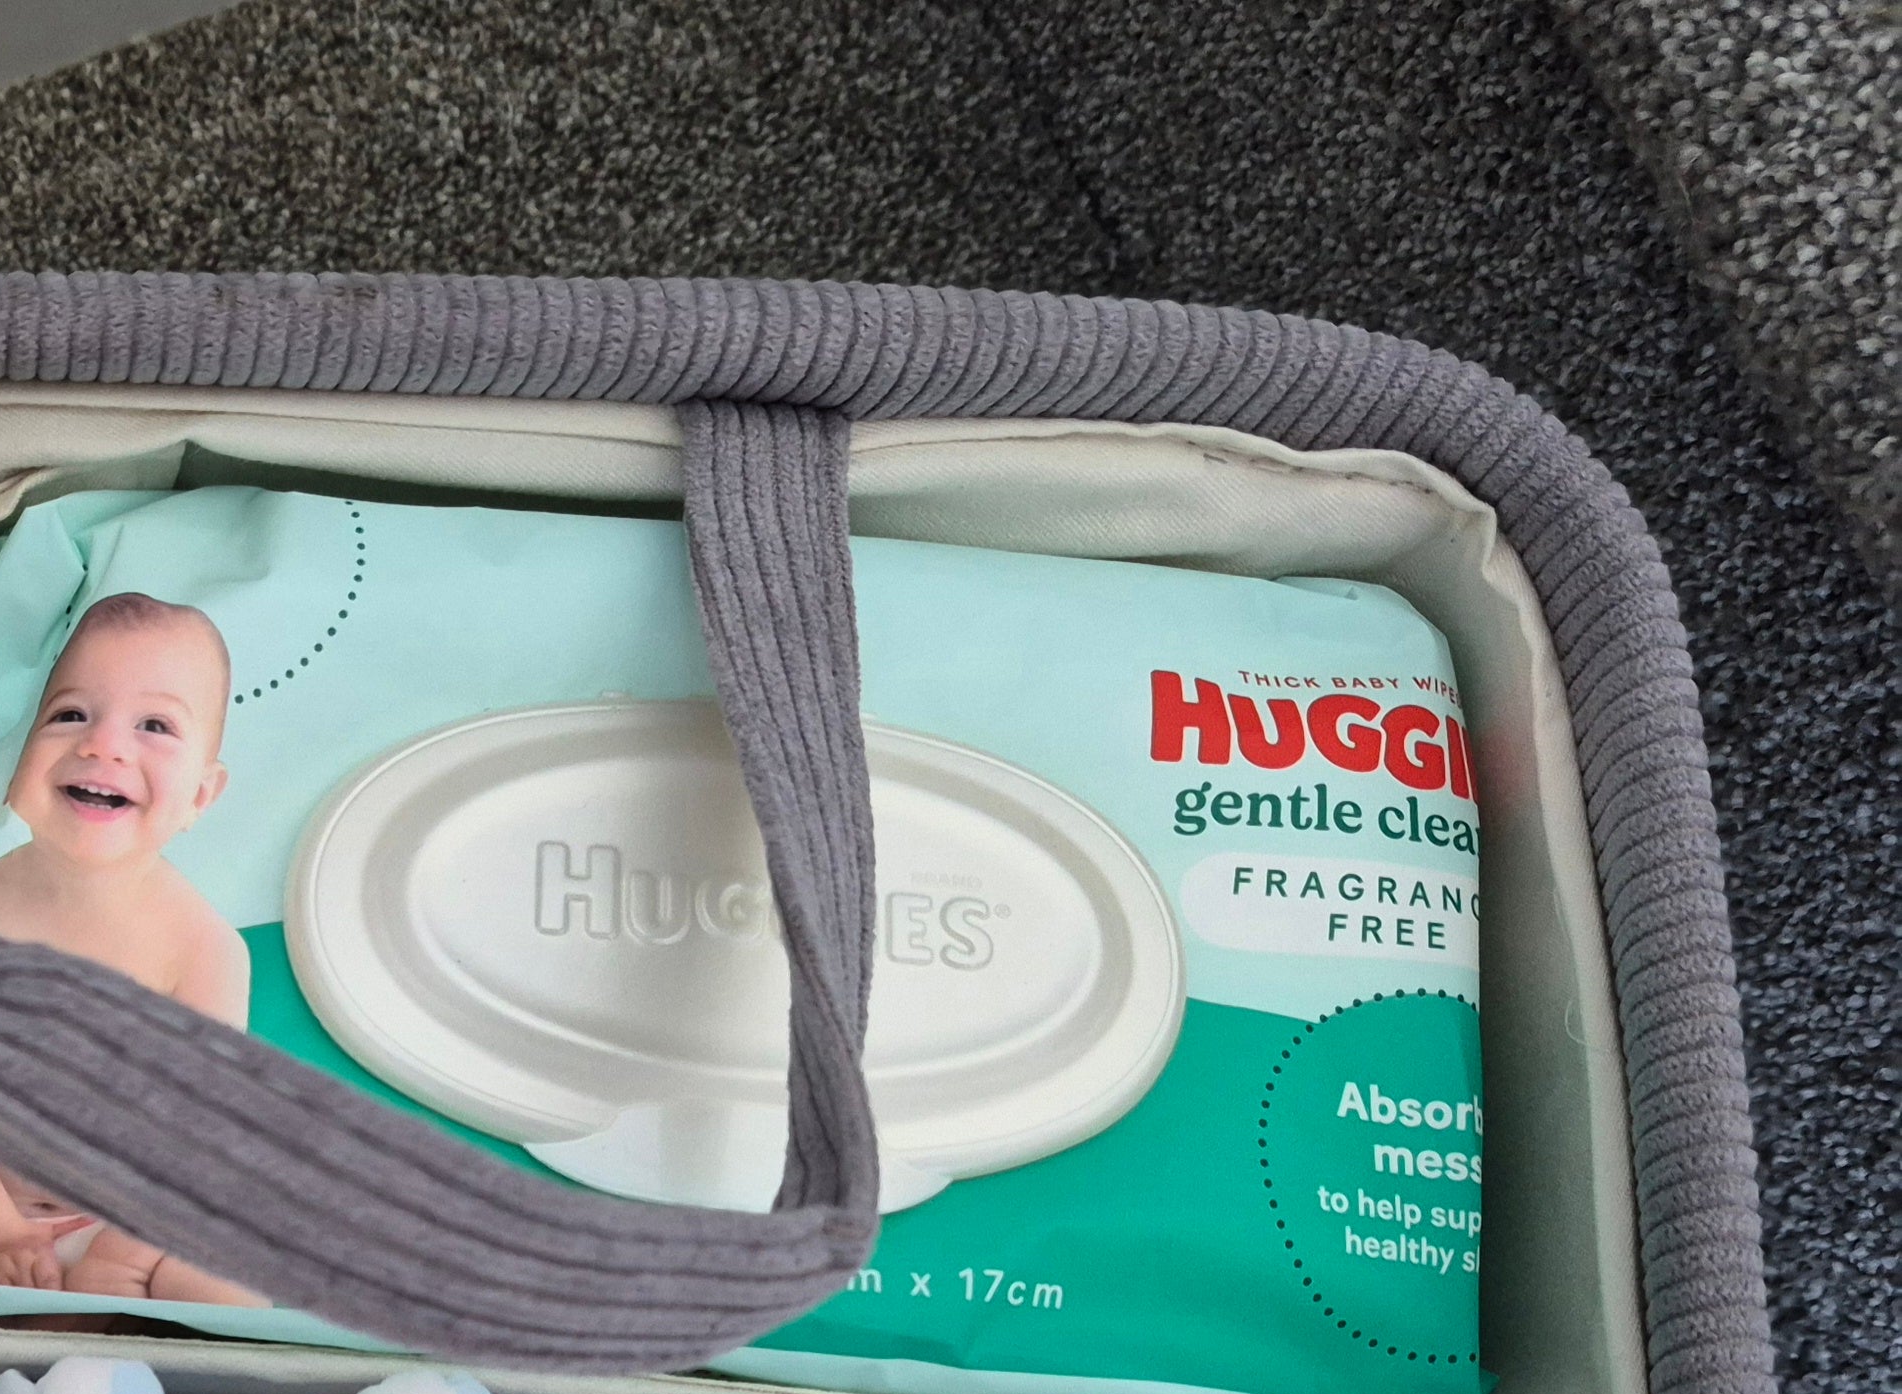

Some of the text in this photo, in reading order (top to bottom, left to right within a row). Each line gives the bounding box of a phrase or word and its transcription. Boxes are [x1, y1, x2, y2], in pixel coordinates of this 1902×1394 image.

[1238, 670, 1320, 690] THICK
[1332, 676, 1401, 691] BABY
[1173, 781, 1363, 836] gentle
[532, 839, 995, 971] HUGES
[1232, 866, 1481, 923] FRAGRANC
[1327, 913, 1447, 950] FREE
[1335, 1080, 1484, 1137] Absorb
[1372, 1142, 1484, 1185] mess
[1316, 1184, 1483, 1240] to help sup
[1344, 1224, 1481, 1276] healthy s
[845, 1265, 1066, 1311] m x 17cm
